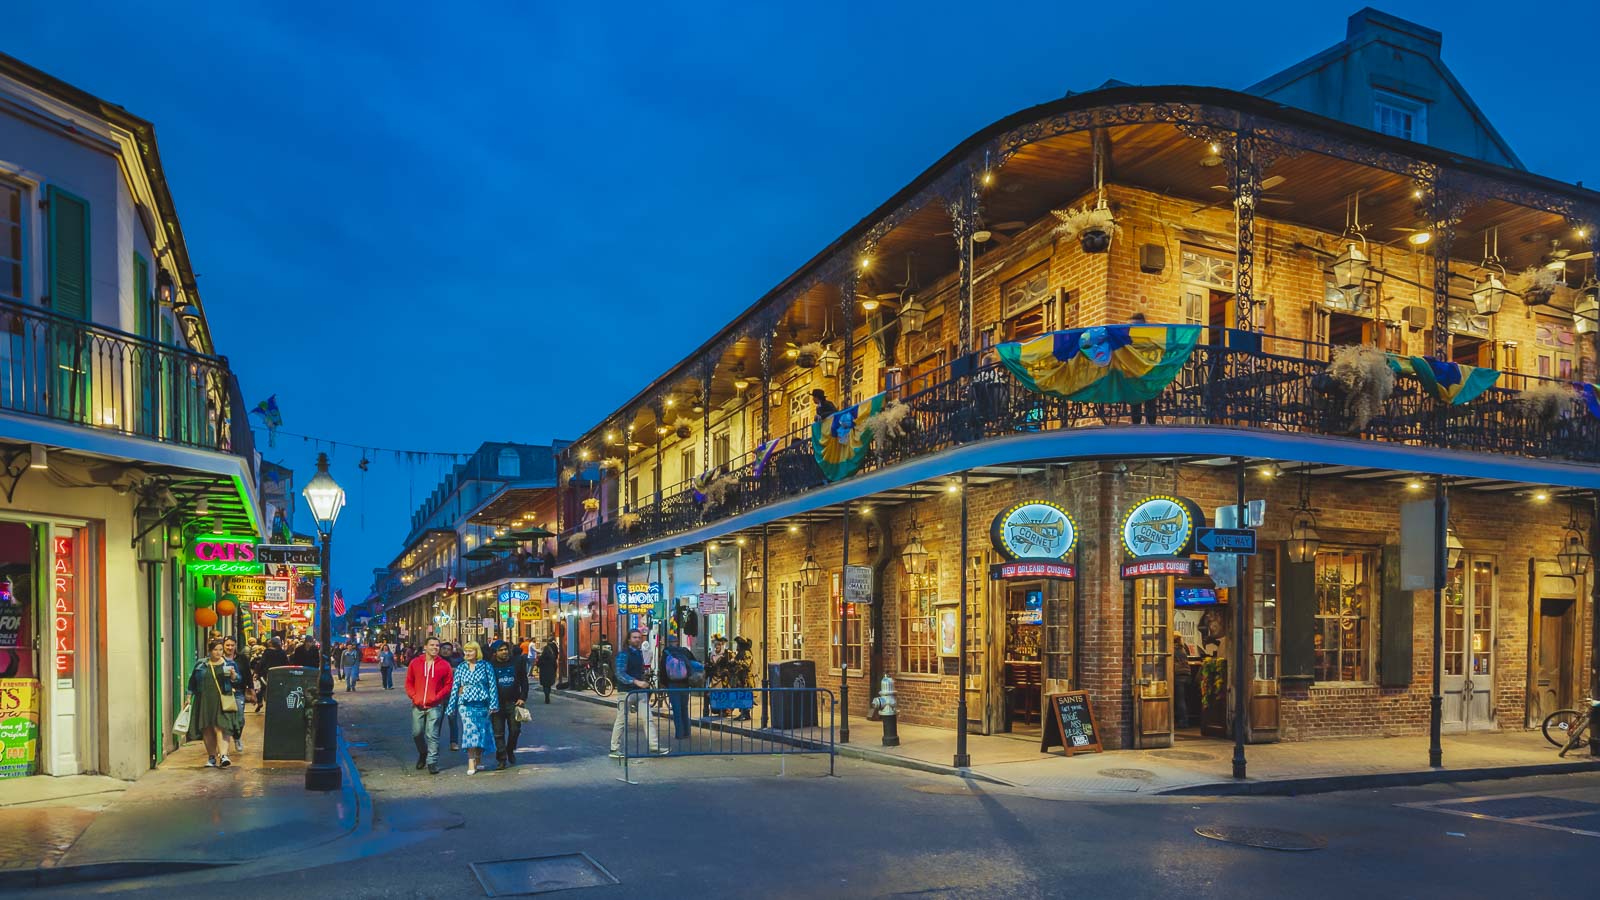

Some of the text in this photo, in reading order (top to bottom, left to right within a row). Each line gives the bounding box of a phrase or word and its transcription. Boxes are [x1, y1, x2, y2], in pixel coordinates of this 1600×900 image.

[1019, 527, 1053, 548] CORNET
[1141, 526, 1172, 545] CORNET
[1215, 536, 1250, 546] ONE WAY
[260, 552, 316, 562] St. Peter
[193, 563, 256, 572] meow
[1002, 565, 1072, 576] NEW ORLEANS CUISINE
[1125, 561, 1191, 575] NEW ORLEANS CUISINE
[54, 539, 68, 670] KARAOKE
[1058, 696, 1083, 705] SAINTS
[1071, 720, 1082, 728] ASS
[1, 730, 29, 740] Original
[7, 747, 25, 759] FOR
[24, 738, 37, 761] 1
